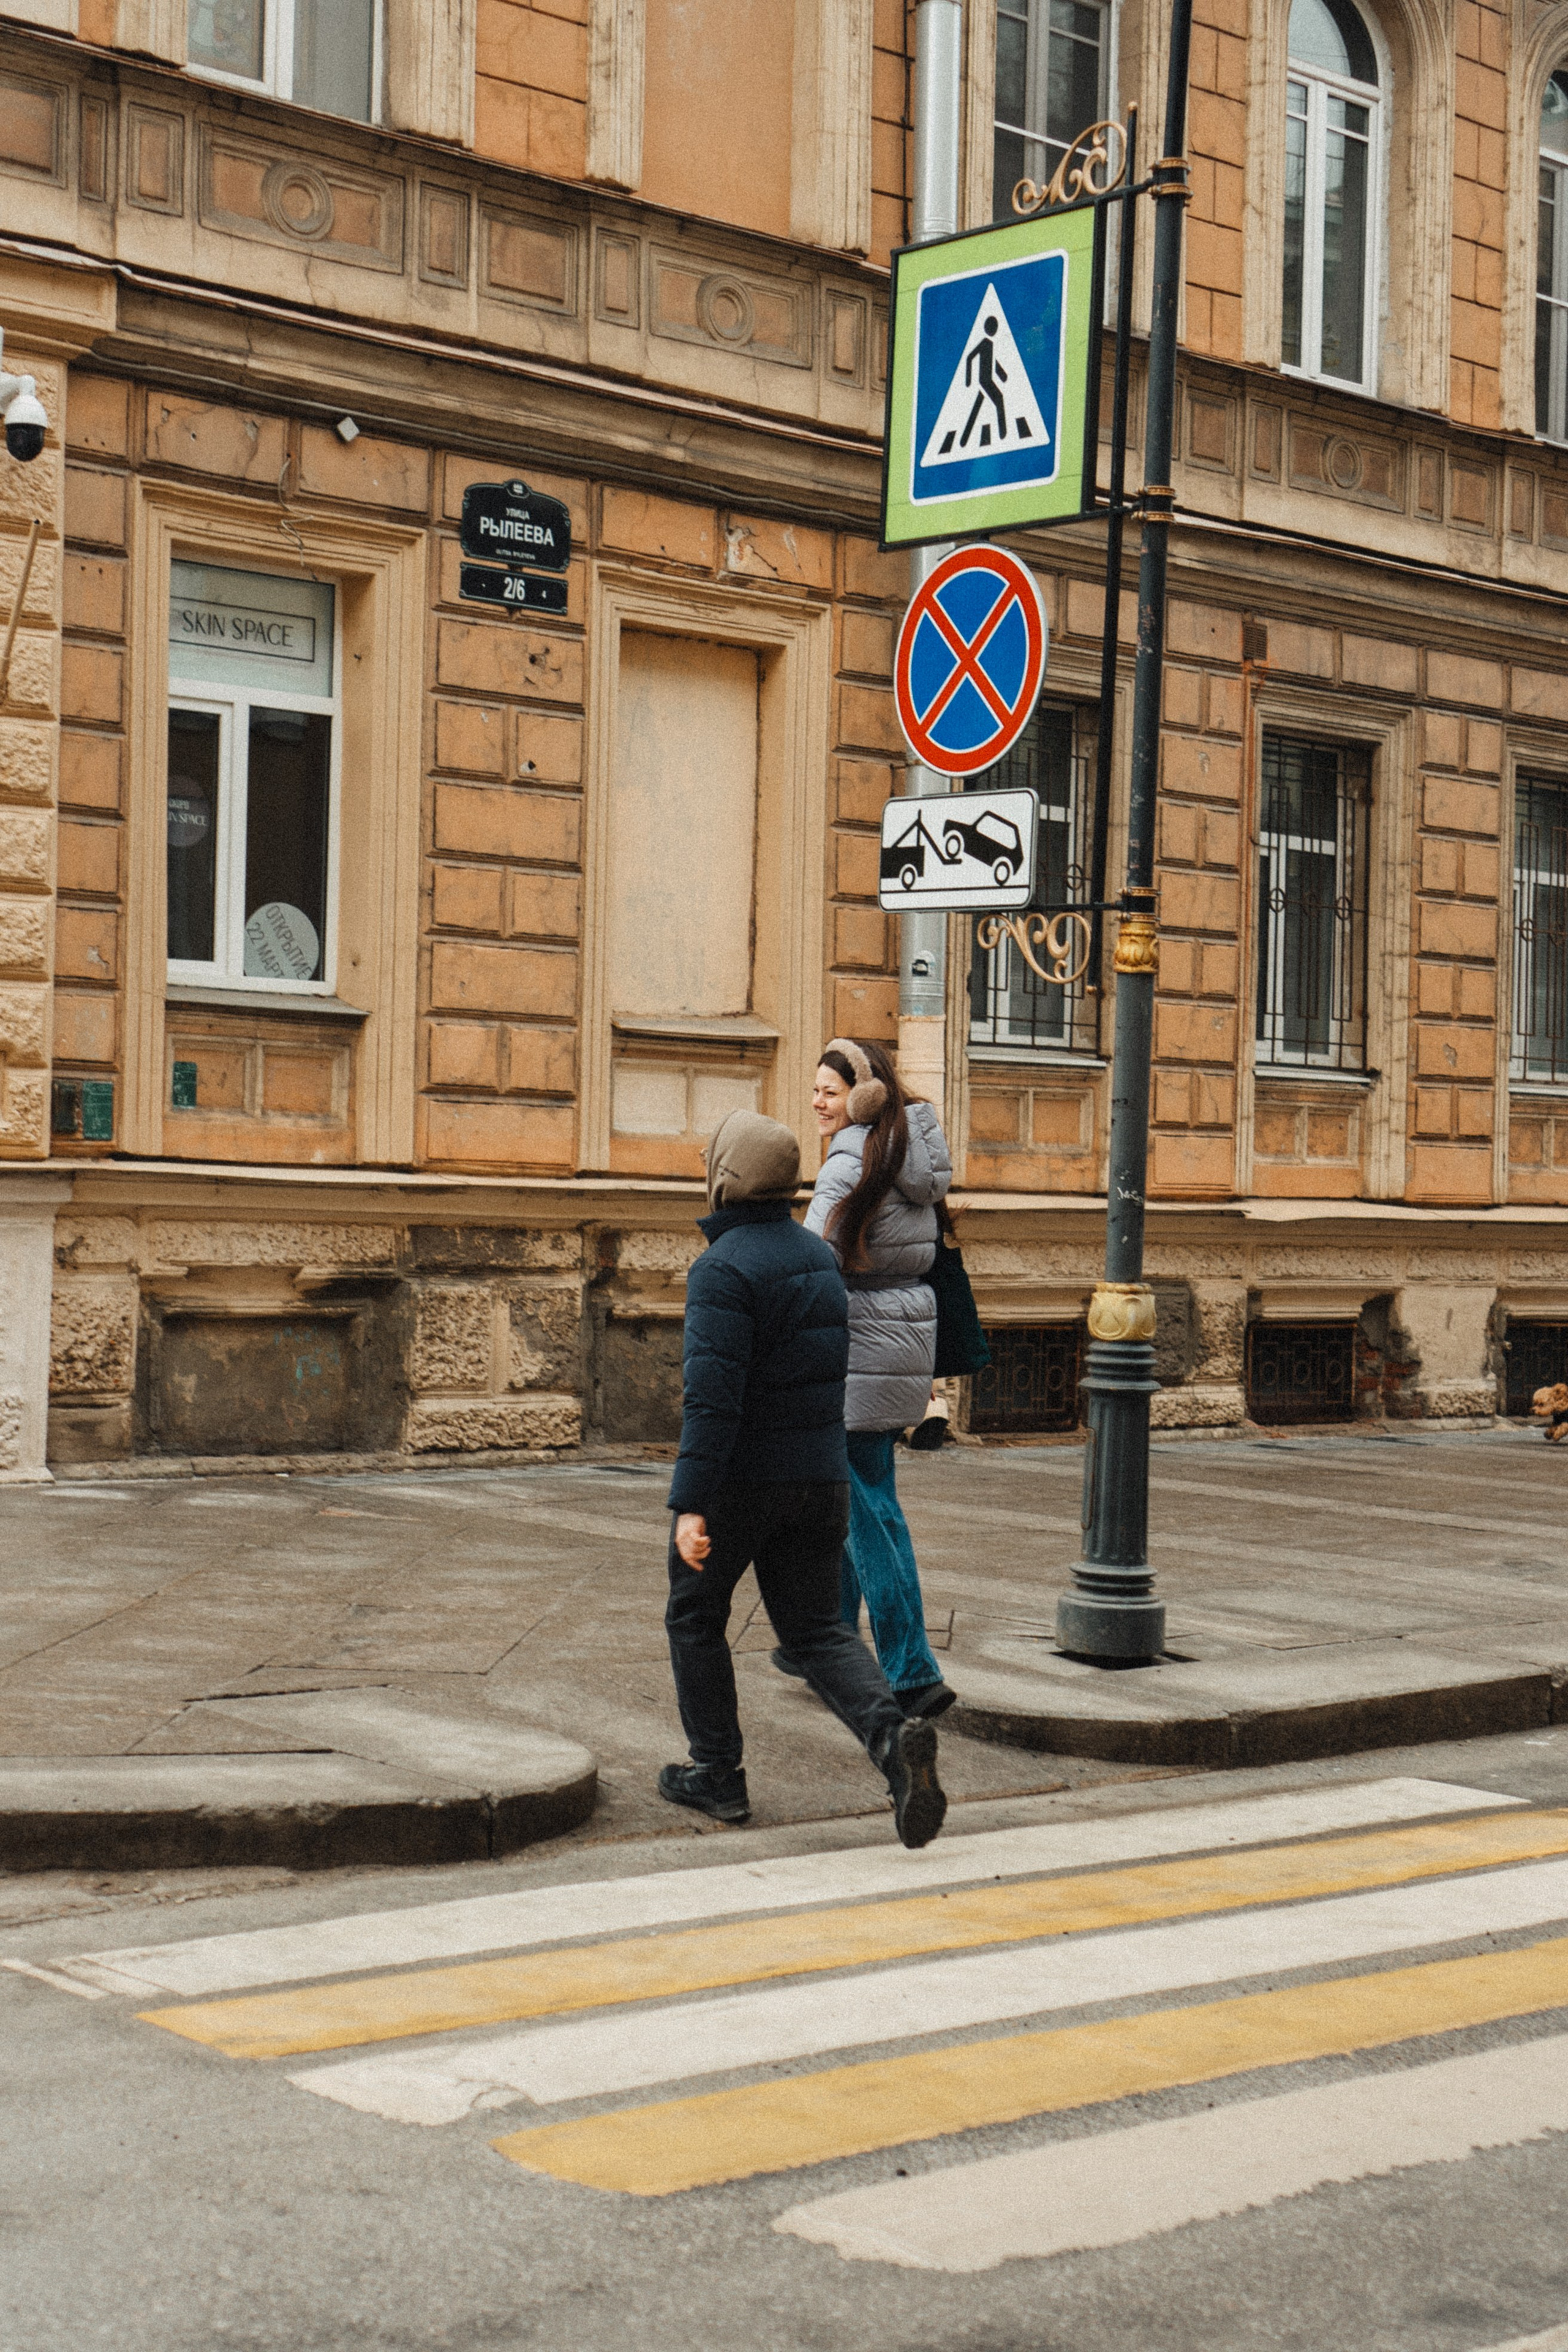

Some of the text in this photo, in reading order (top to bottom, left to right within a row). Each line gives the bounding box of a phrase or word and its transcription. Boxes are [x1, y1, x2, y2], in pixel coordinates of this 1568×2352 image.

[505, 507, 530, 520] УЛИЦА
[479, 516, 555, 547] РЫЛЕЕВА
[503, 576, 526, 601] 2/6
[182, 609, 295, 647] SKIN SPACE
[246, 921, 265, 946] 22
[265, 904, 313, 980] ОТКРЫТИЕ
